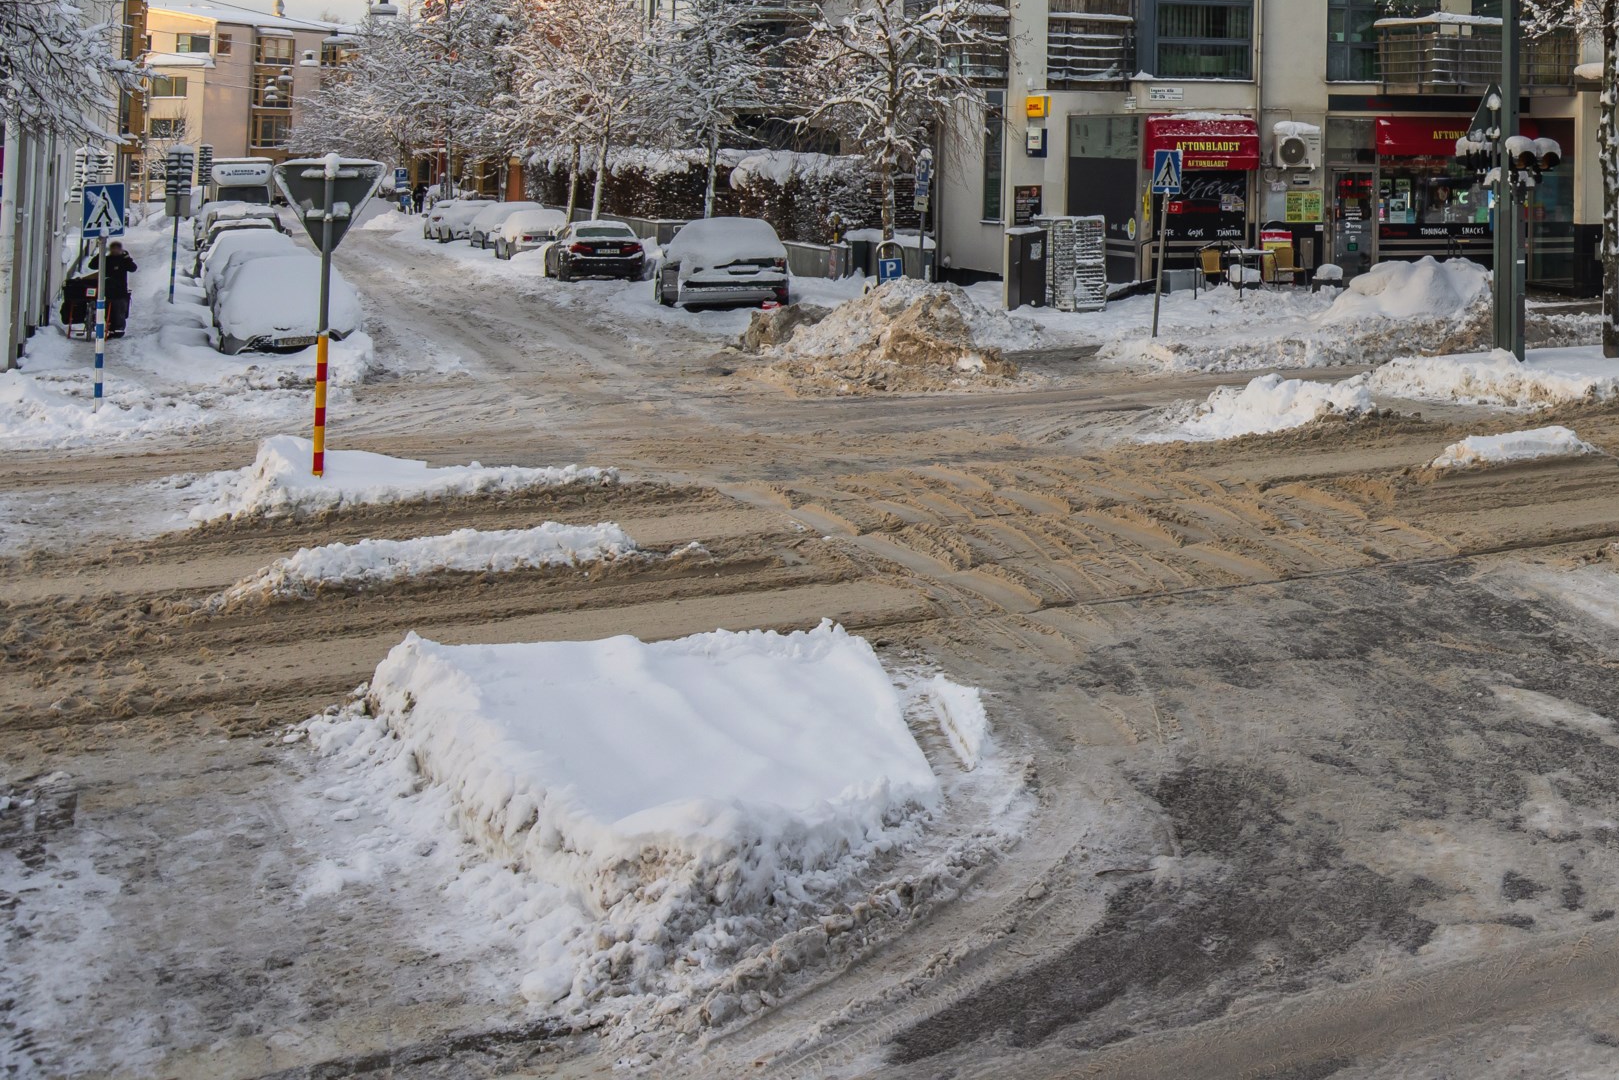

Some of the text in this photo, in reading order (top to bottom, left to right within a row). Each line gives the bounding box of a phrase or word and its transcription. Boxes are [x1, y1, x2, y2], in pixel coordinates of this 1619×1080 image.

[1433, 130, 1466, 140] AFTONB
[1176, 142, 1240, 151] AFTONBLADET
[1157, 228, 1241, 237] KFFE GODIS TJÄNSTER
[1462, 227, 1484, 235] SNACKS
[886, 262, 896, 276] P
